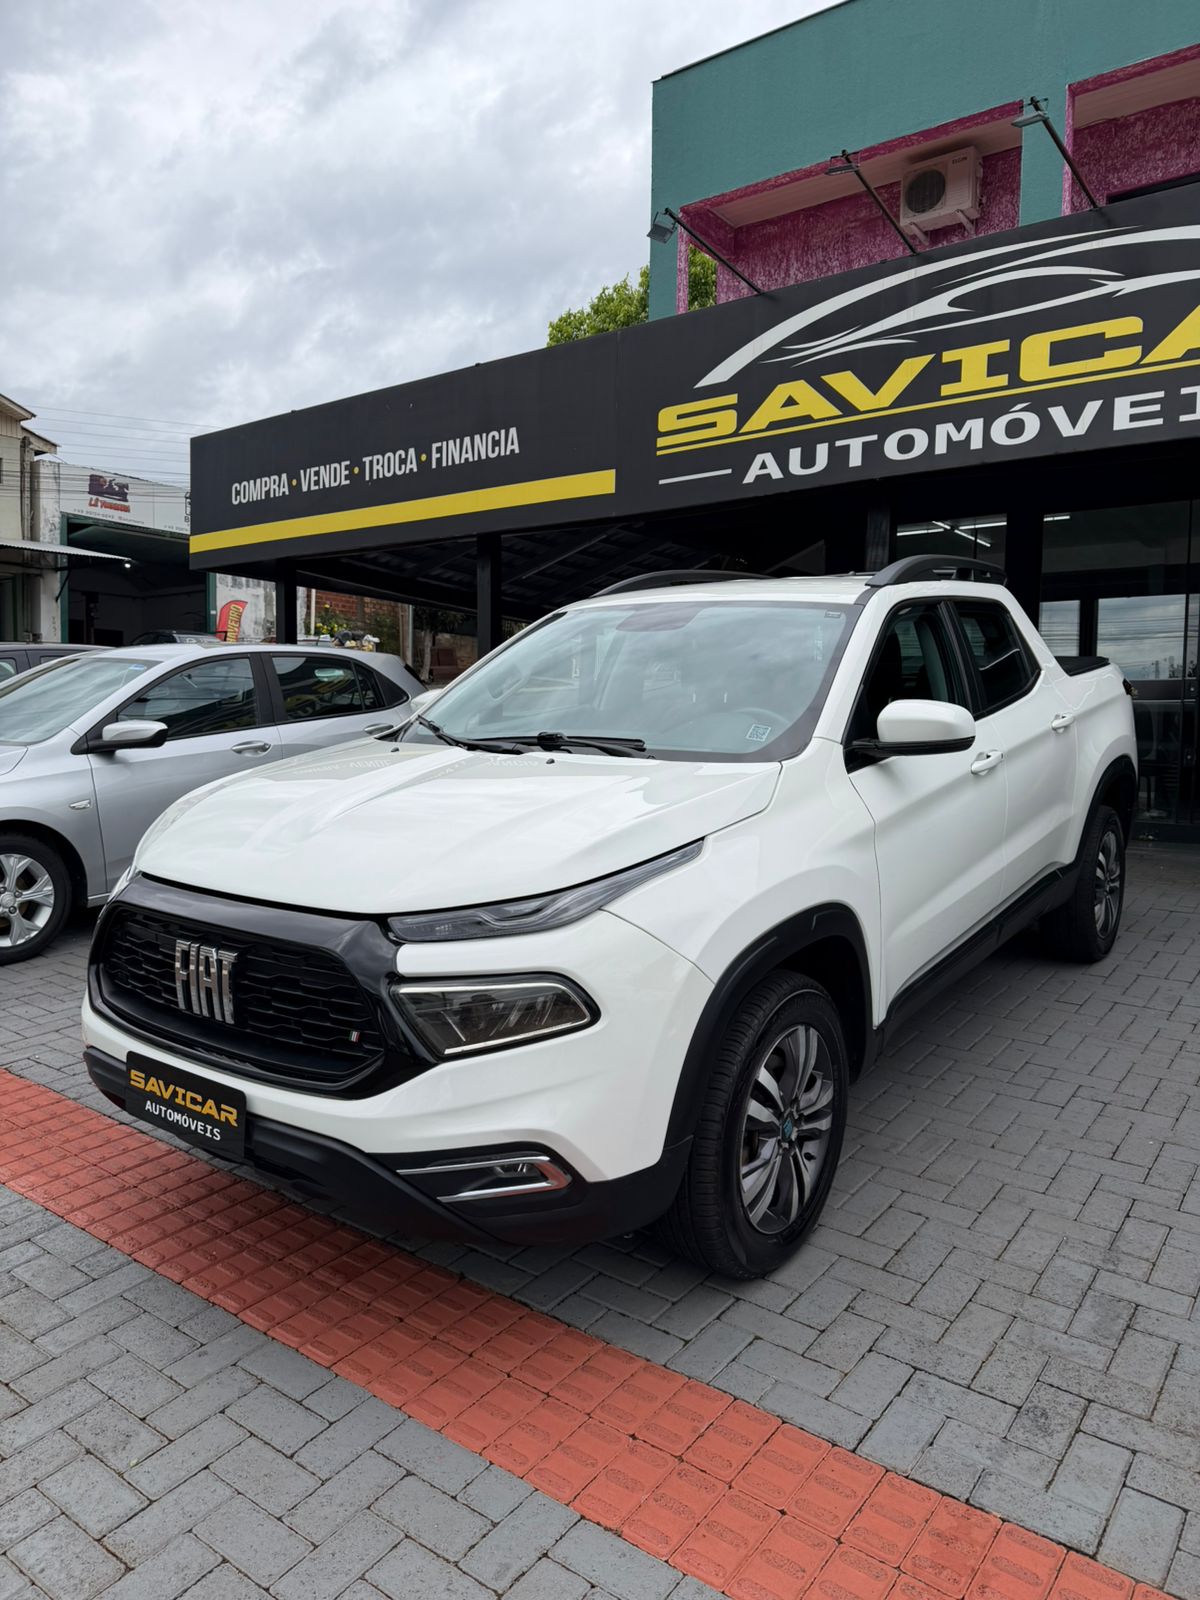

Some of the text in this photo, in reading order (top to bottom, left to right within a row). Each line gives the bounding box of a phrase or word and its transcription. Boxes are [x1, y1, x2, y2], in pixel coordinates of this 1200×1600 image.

[231, 427, 520, 505] COMPRA VENDE TROCA FINANCIA
[174, 939, 239, 1025] FIAT
[129, 1069, 238, 1127] SAVICAR
[145, 1100, 221, 1141] AUTOMÓVEIS
